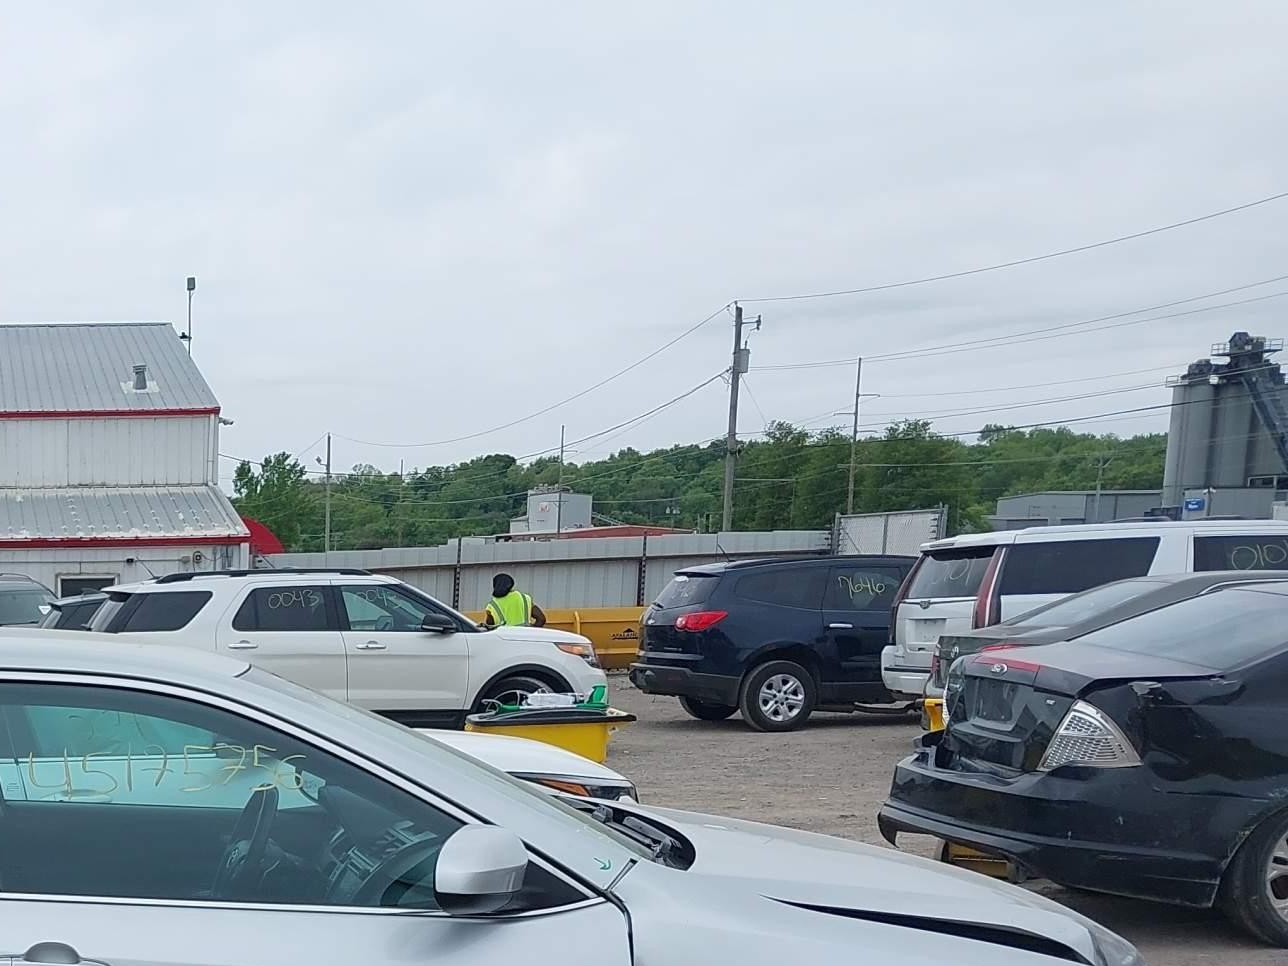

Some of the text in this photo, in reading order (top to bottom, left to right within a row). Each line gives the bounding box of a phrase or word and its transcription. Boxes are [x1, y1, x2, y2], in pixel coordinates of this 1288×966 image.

[268, 589, 320, 609] 0043
[838, 575, 886, 599] 7646
[27, 743, 307, 800] 45175756
